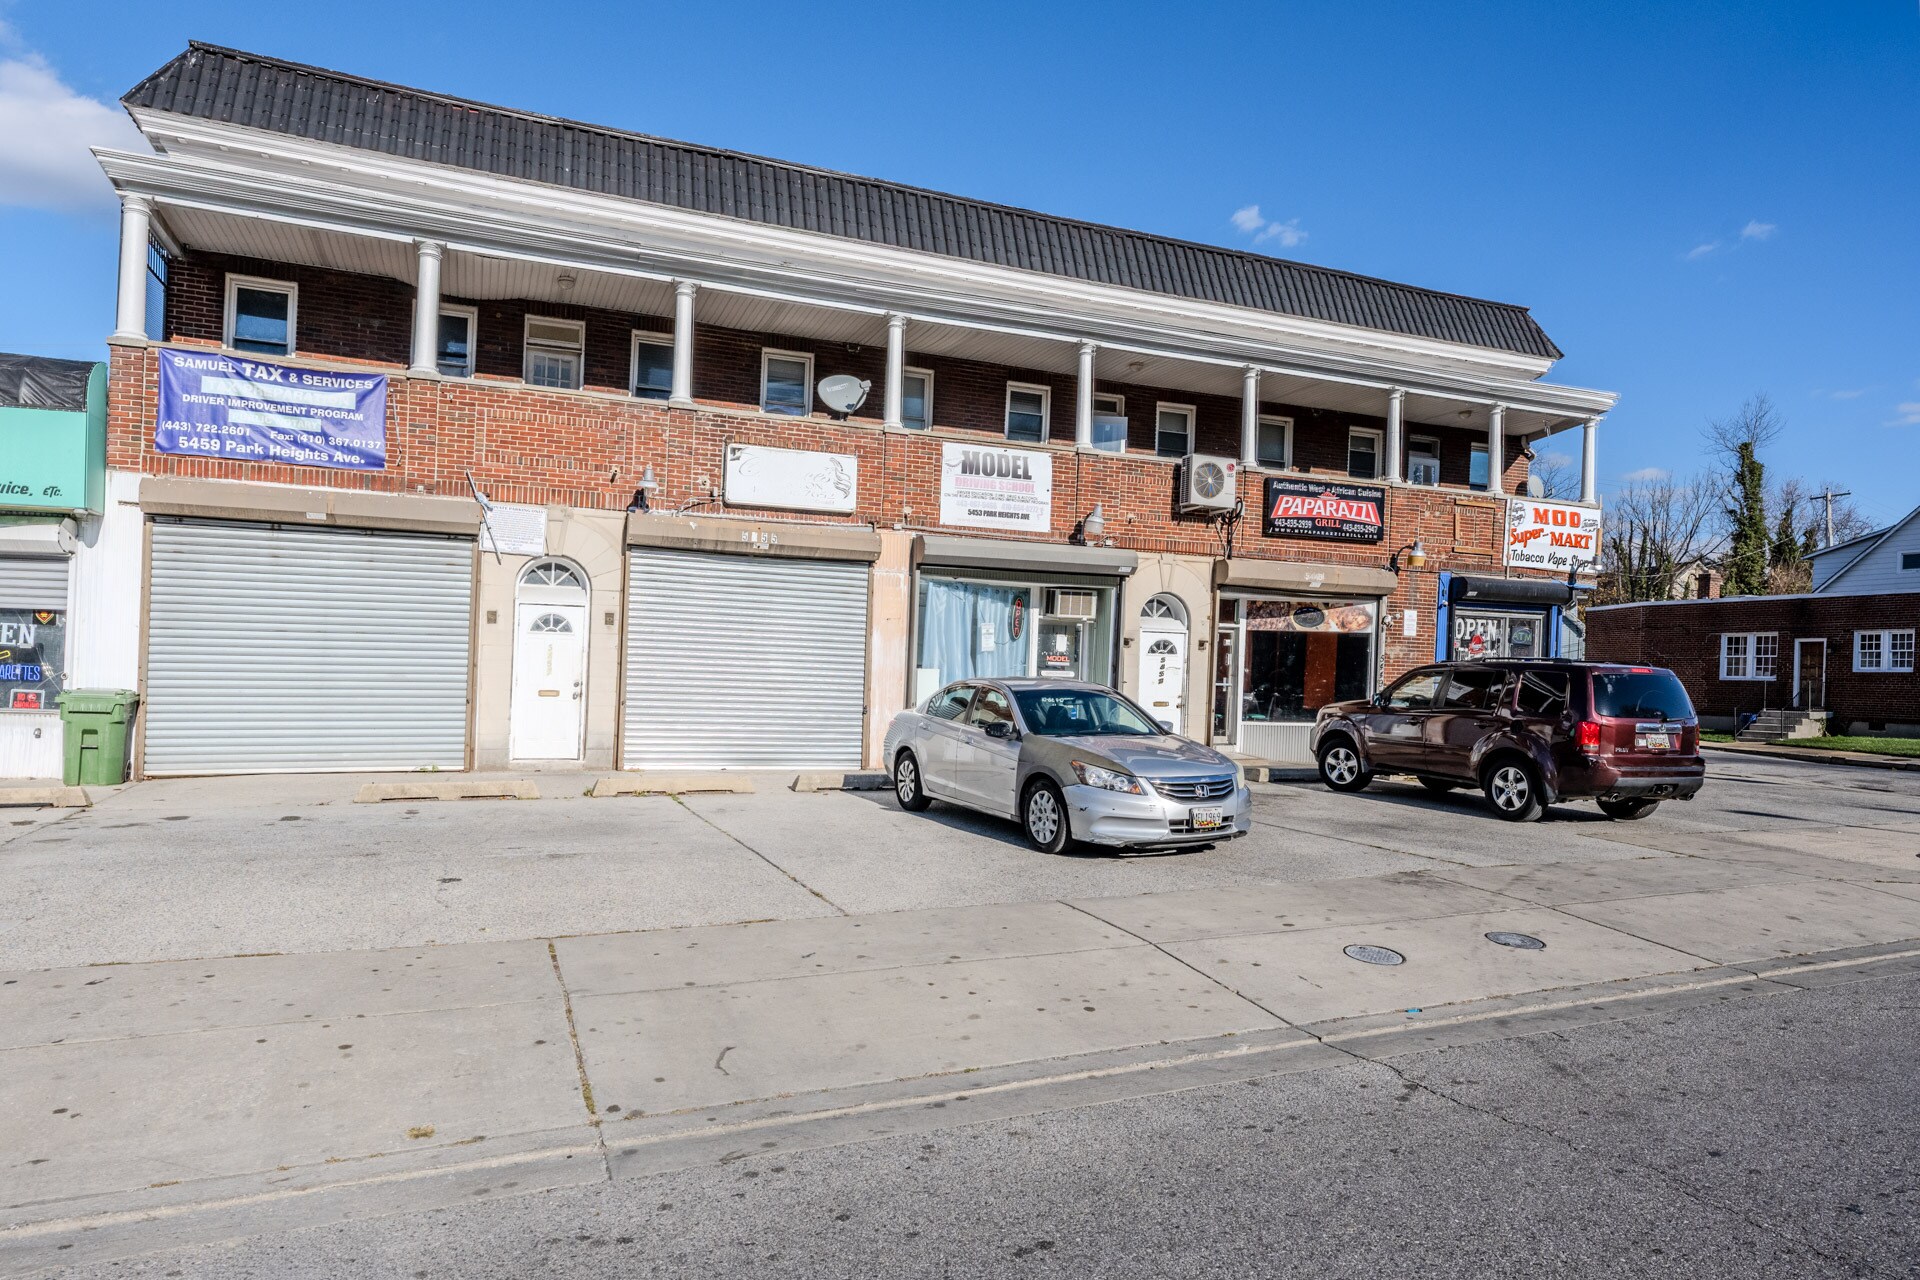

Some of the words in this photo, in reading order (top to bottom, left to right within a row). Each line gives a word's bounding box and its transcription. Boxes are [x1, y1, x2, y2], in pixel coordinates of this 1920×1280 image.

[174, 357, 236, 373] SAMUEL
[241, 362, 283, 383] TAX
[289, 373, 298, 383] &
[302, 374, 374, 389] SERVICES
[182, 394, 224, 406] DRIVER
[227, 398, 307, 415] IMPROVEMENT
[310, 408, 363, 421] PROGRAM
[161, 420, 191, 432] (443)
[195, 423, 250, 436] 722.2601
[270, 431, 294, 442] Fax:
[297, 433, 325, 445] (410)
[329, 436, 382, 450] 367.0137
[178, 437, 221, 450] 5459
[226, 441, 264, 456] Park
[270, 443, 329, 462] Heights
[333, 452, 365, 464] Ave.
[961, 450, 1032, 480] MODEL
[955, 477, 997, 490] DRIVING
[999, 480, 1035, 493] SCHOOL
[1273, 481, 1308, 491] Authentic
[1308, 484, 1326, 493] West
[1331, 485, 1356, 496] African
[1357, 488, 1382, 498] Cuisine
[998, 511, 1020, 520] HEIGHTS
[1277, 496, 1376, 523] PAPARAZZI
[1315, 518, 1341, 528] GRILL
[1550, 531, 1593, 549] MART
[1511, 549, 1544, 563] Tobacco
[1547, 551, 1568, 568] Vape
[1569, 554, 1590, 571] Shop
[1455, 618, 1498, 641] OPEN
[1512, 631, 1533, 642] ATM
